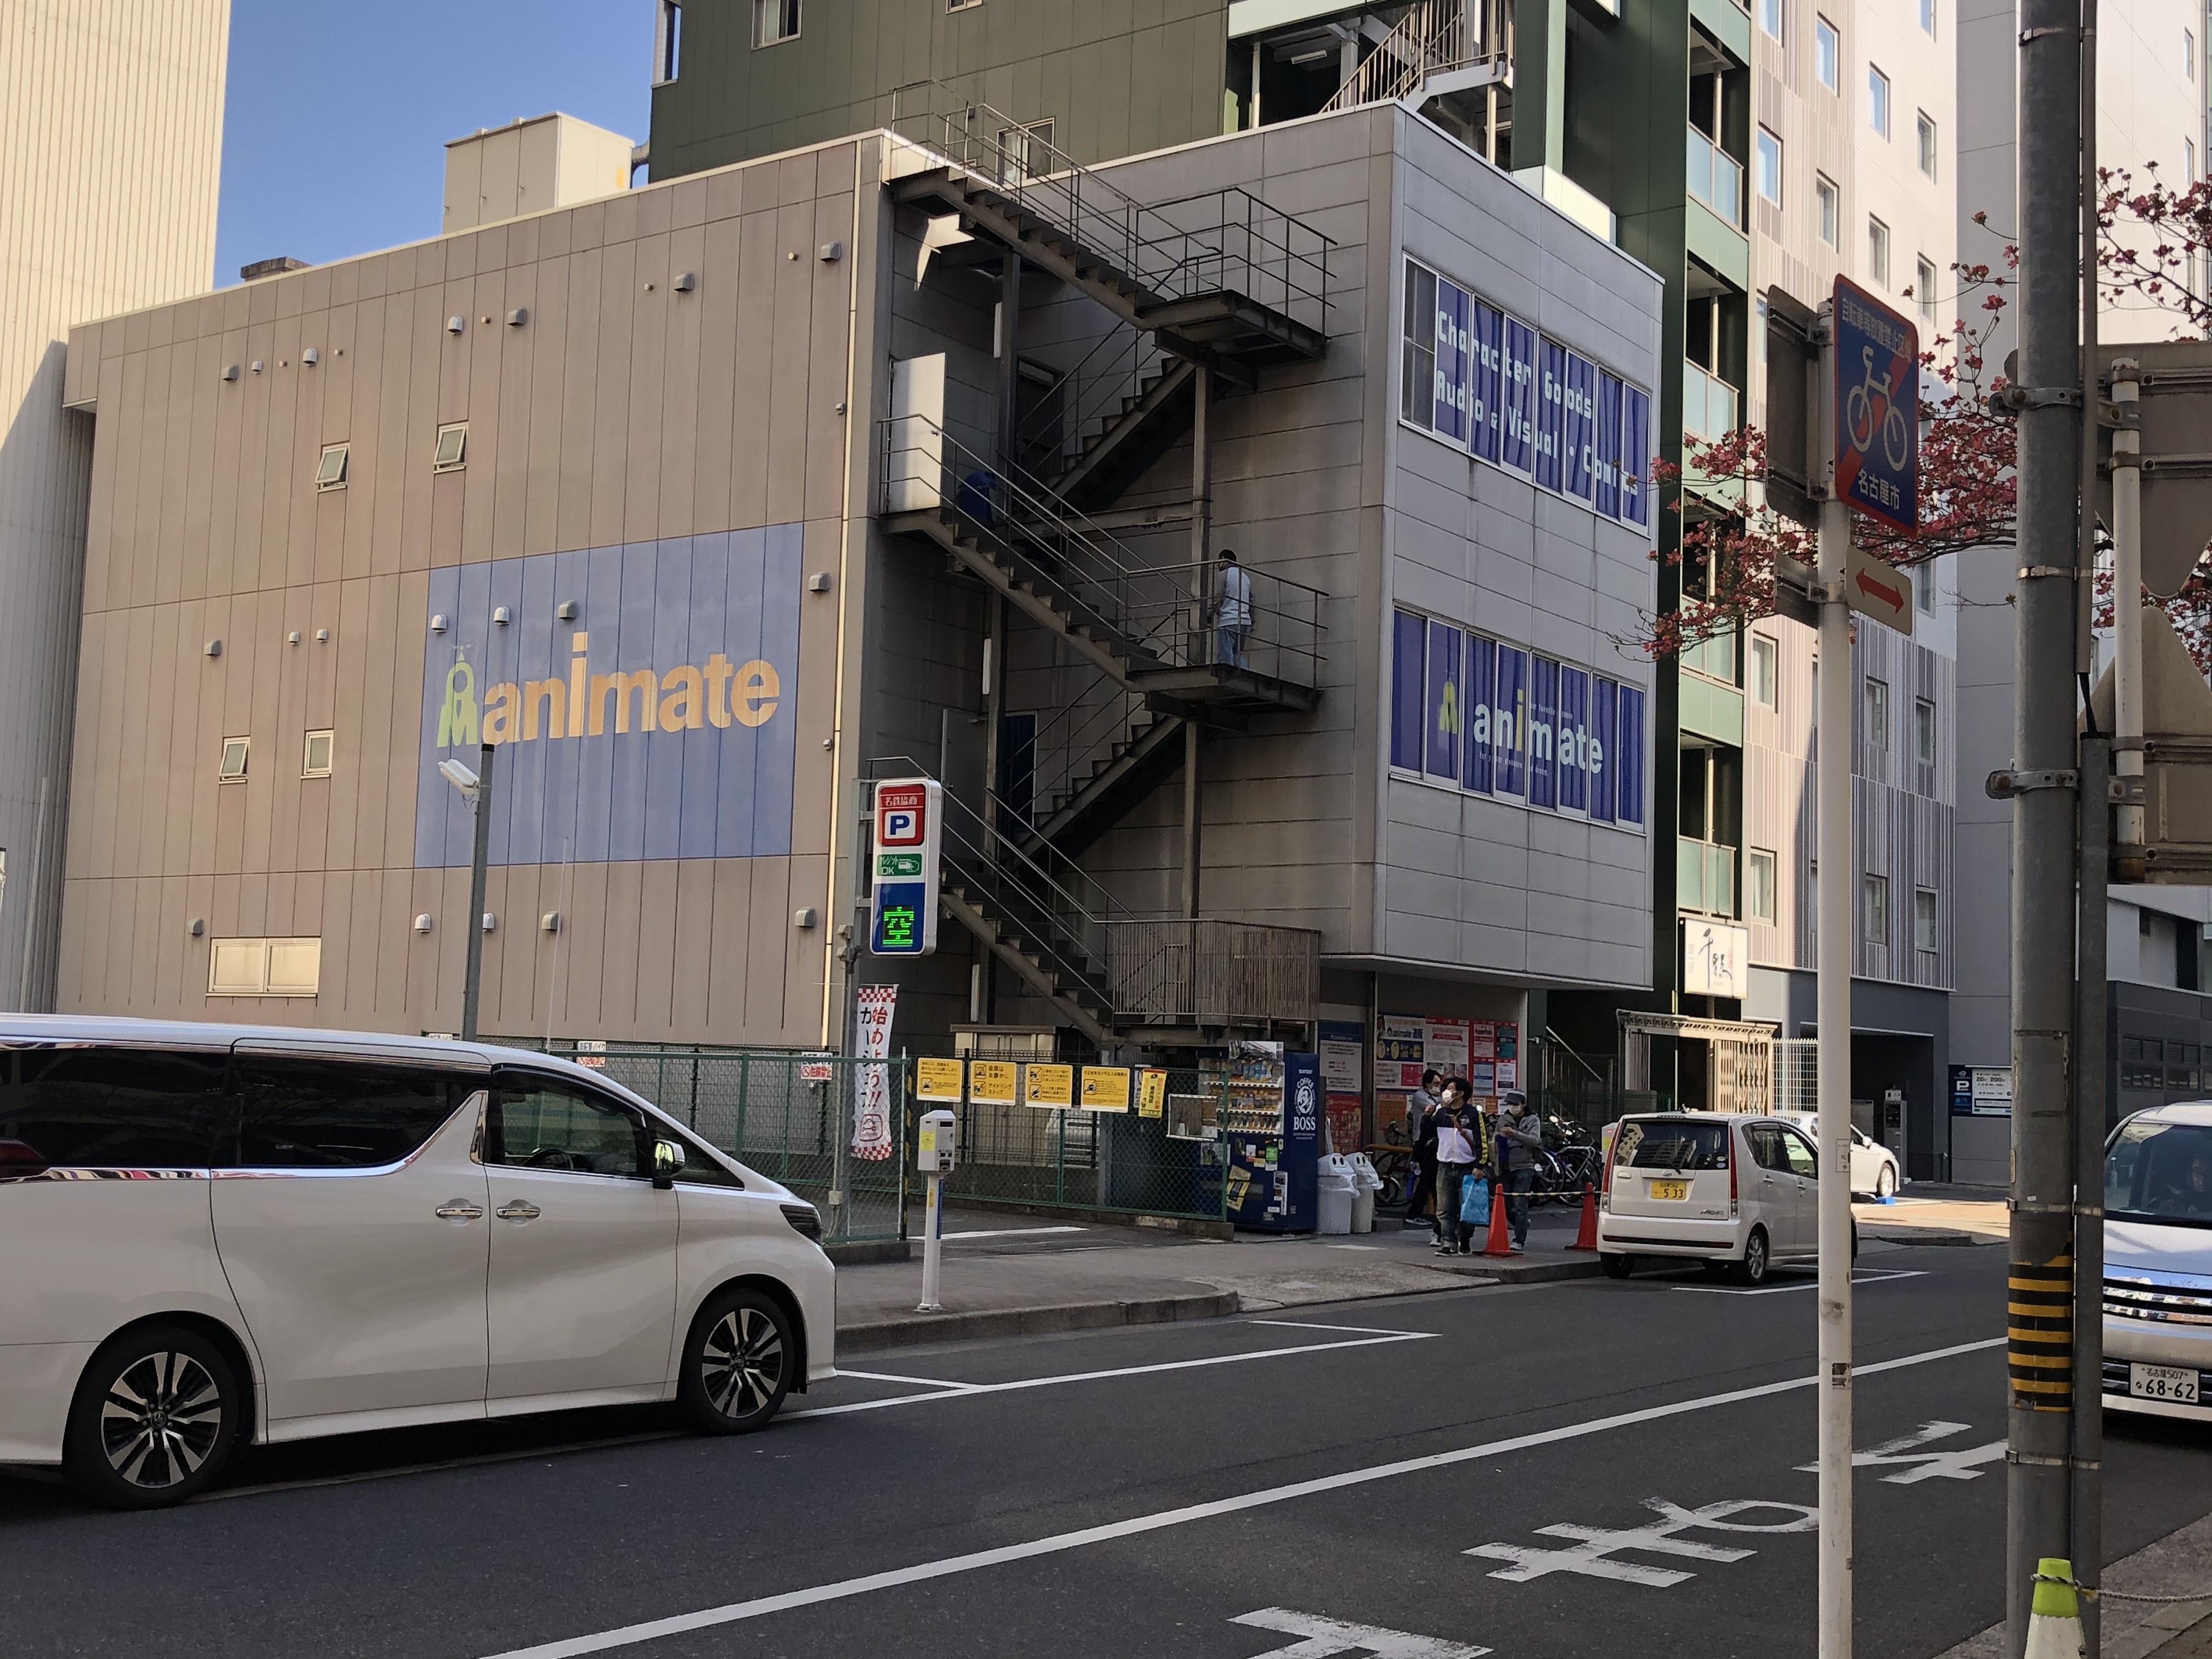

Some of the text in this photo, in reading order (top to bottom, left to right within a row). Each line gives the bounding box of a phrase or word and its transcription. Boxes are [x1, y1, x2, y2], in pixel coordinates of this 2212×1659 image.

[1437, 310, 1593, 420] Character Goods
[1436, 369, 1483, 423] Audio
[1508, 405, 1558, 459] Visual
[1857, 469, 1900, 511] 名古屋市
[482, 631, 780, 745] animate
[1473, 689, 1603, 774] animate
[885, 796, 918, 806] 名鉄協商
[890, 815, 910, 836] P
[881, 867, 895, 875] OK
[883, 906, 915, 946] 空
[1956, 1081, 1970, 1091] P
[1293, 1116, 1316, 1130] BOSS
[2146, 1379, 2195, 1400] 68-62
